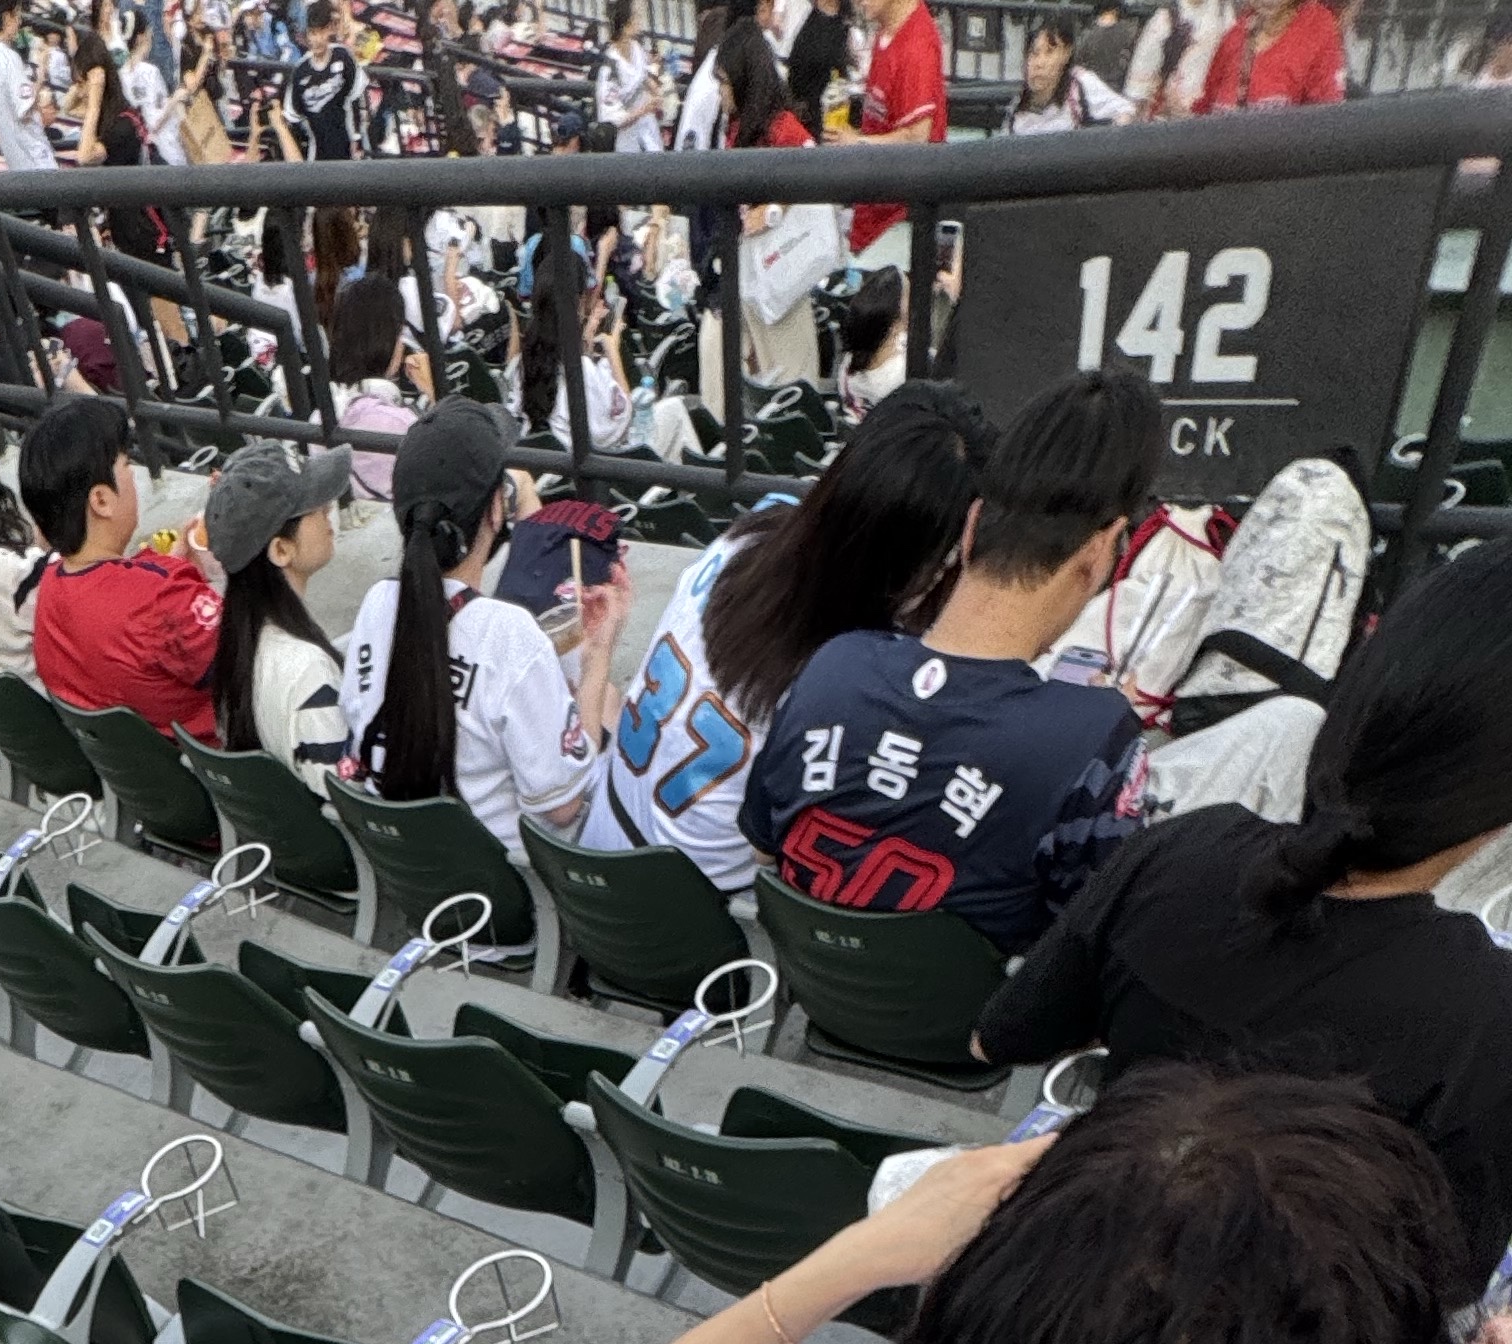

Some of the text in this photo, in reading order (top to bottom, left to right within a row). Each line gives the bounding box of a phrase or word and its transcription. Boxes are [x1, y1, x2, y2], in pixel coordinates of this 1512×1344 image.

[1077, 246, 1273, 383] 142
[618, 630, 752, 819] 37
[801, 725, 1004, 839] 김동혁
[782, 804, 956, 912] 50
